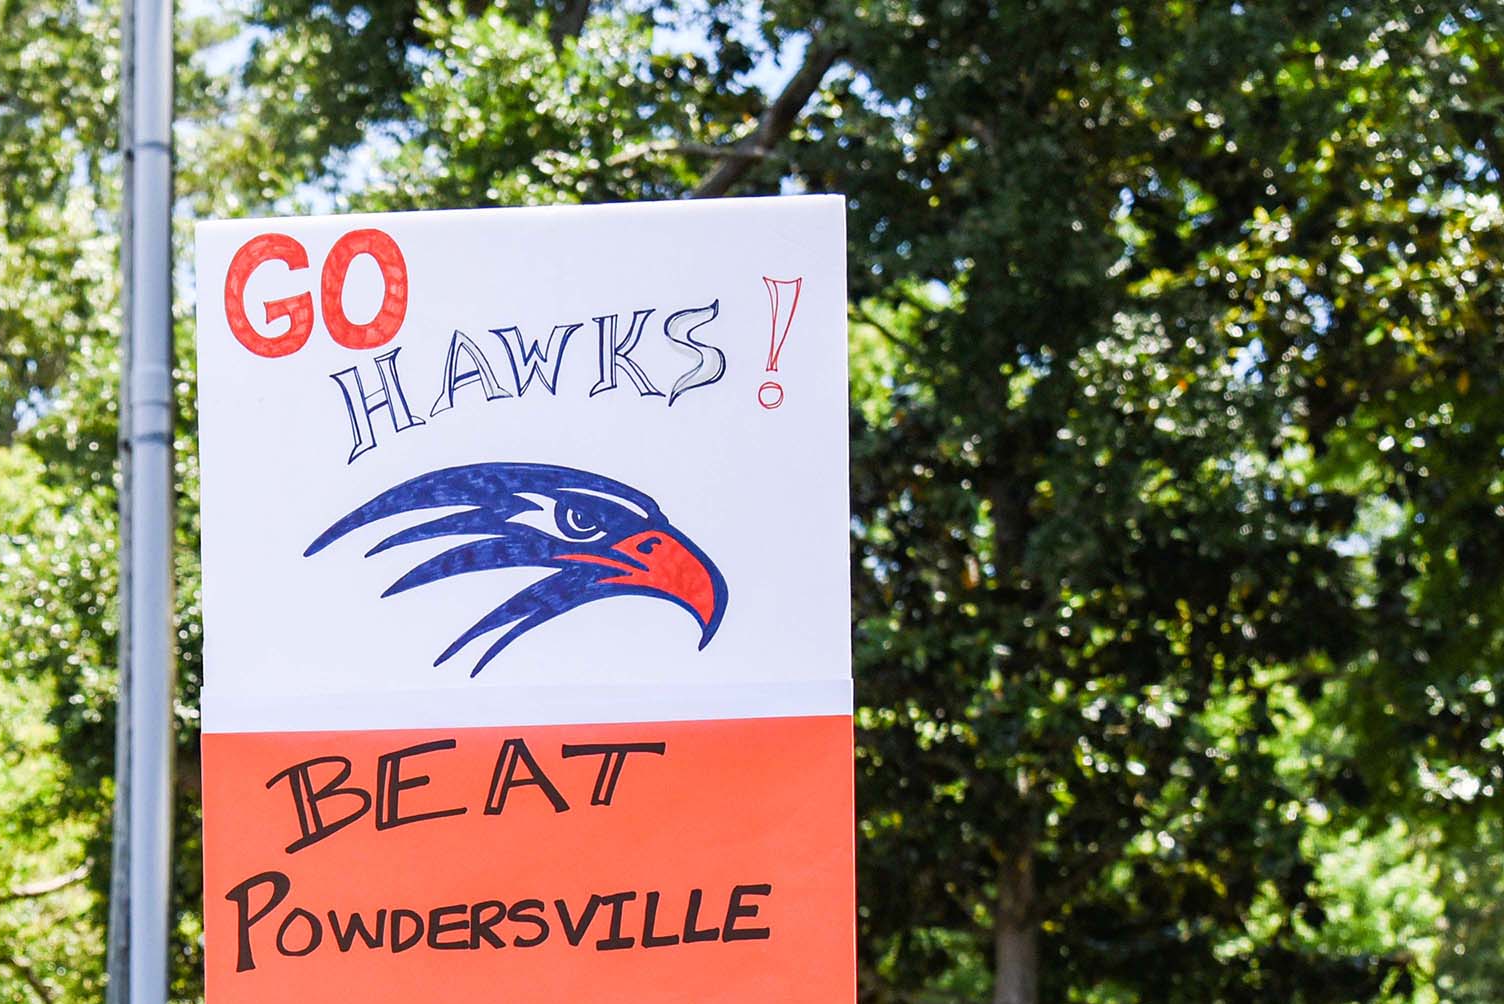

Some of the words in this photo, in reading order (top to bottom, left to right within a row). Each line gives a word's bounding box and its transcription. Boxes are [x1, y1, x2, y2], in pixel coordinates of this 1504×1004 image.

[224, 228, 409, 359] GO
[265, 738, 666, 855] BEAT
[225, 871, 772, 973] POWDERSVILLE
